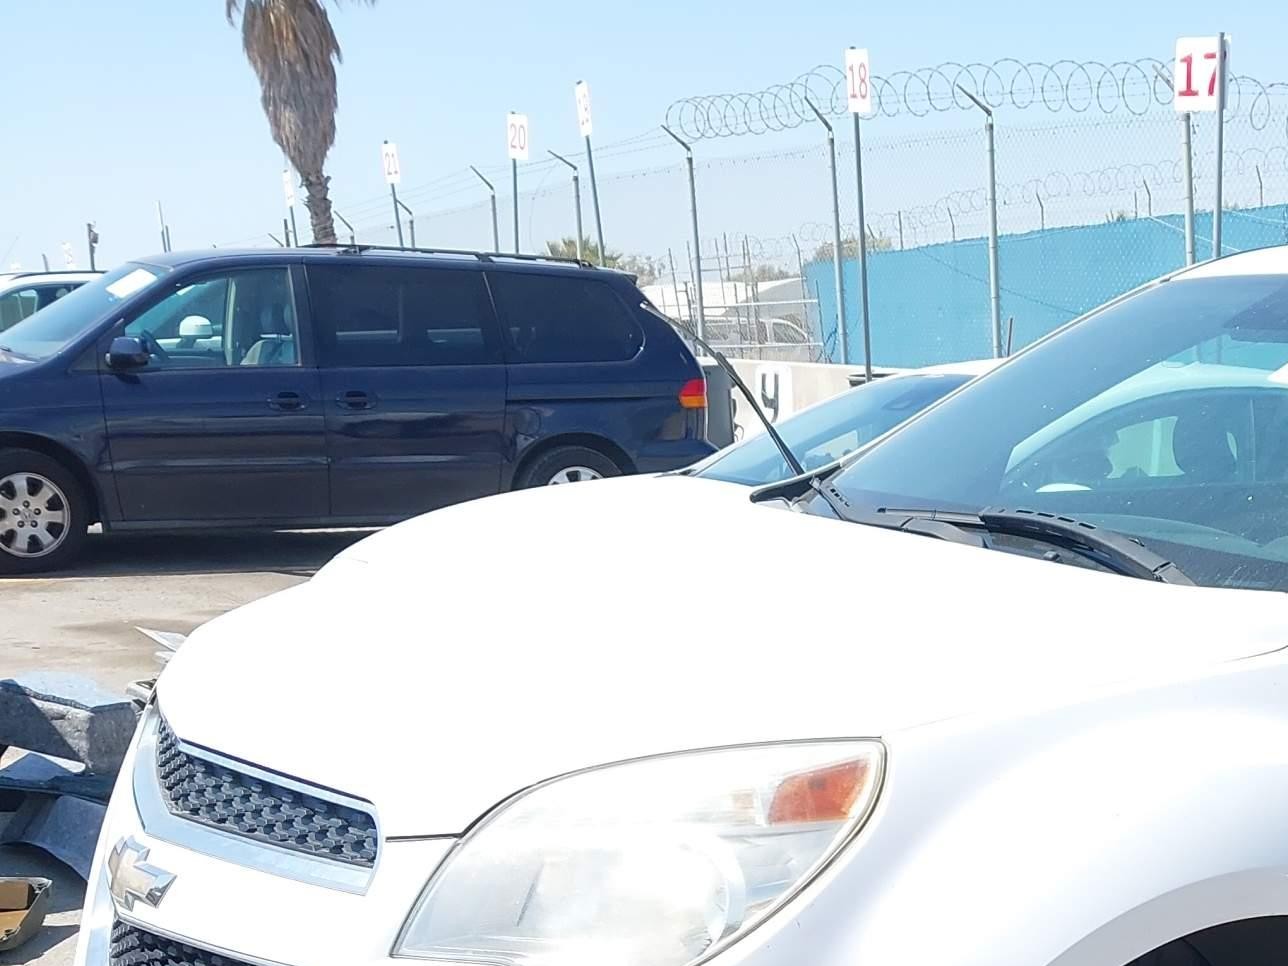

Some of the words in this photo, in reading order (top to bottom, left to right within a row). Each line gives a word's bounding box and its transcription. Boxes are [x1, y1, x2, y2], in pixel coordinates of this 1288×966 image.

[848, 62, 867, 99] 18
[1178, 52, 1217, 96] 17
[509, 122, 526, 150] 20
